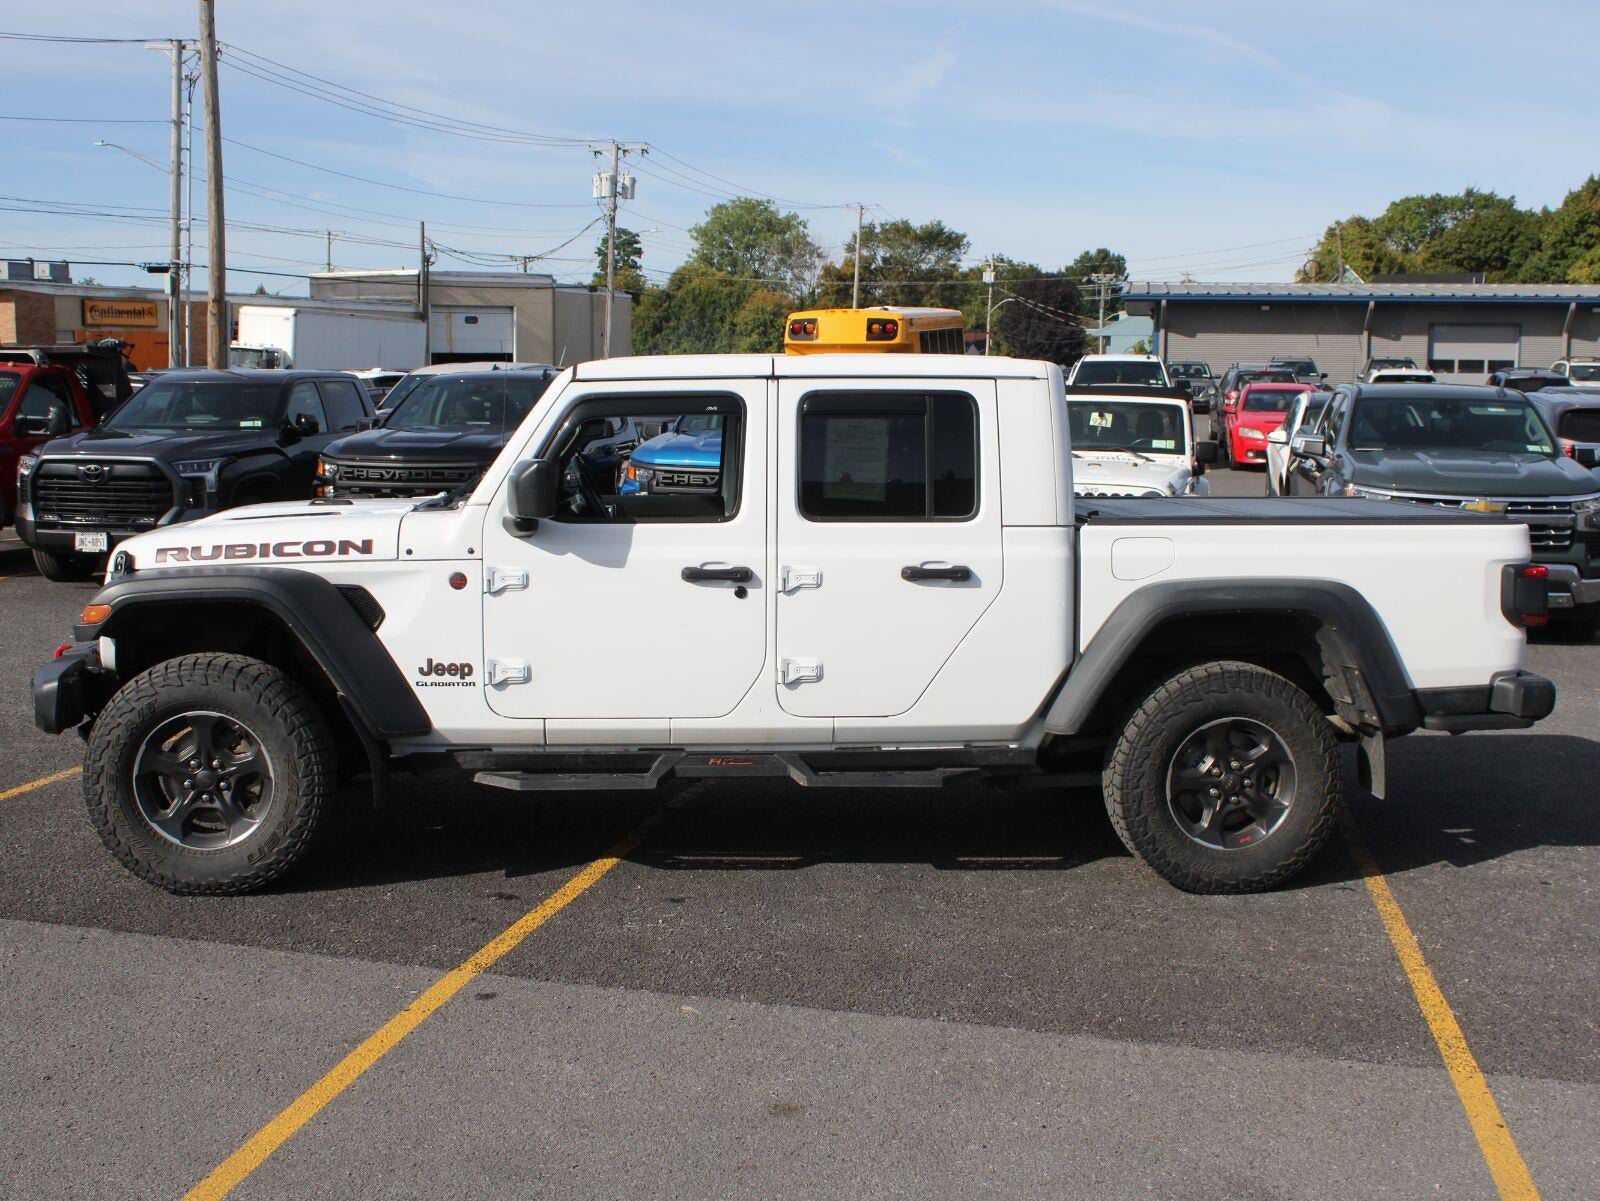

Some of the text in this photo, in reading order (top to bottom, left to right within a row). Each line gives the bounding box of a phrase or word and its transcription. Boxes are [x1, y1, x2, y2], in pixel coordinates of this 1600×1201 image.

[89, 305, 145, 320] Continental
[155, 539, 372, 563] RUBICON
[418, 658, 473, 680] Jeep
